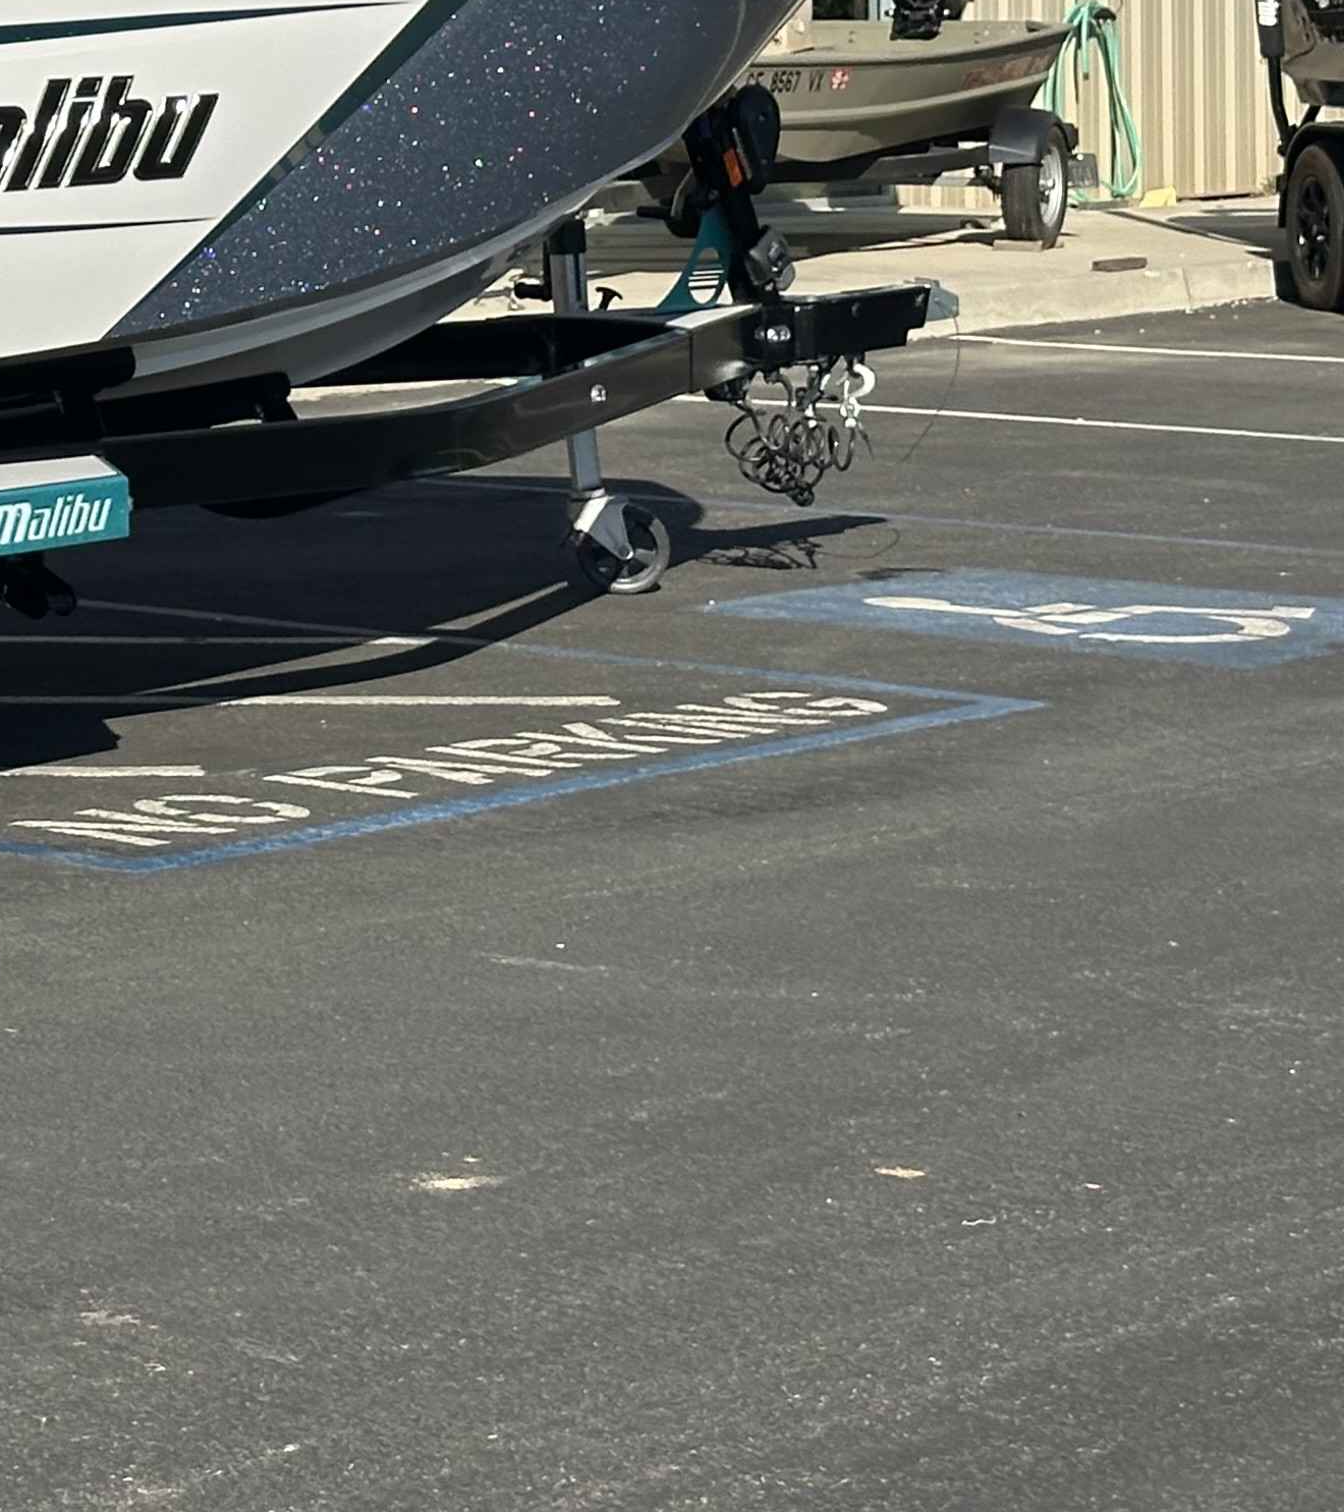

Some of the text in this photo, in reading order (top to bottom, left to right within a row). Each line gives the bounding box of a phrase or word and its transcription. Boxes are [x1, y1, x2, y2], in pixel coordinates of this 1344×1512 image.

[770, 69, 802, 94] 8567
[8, 691, 890, 847] NO PARKING
